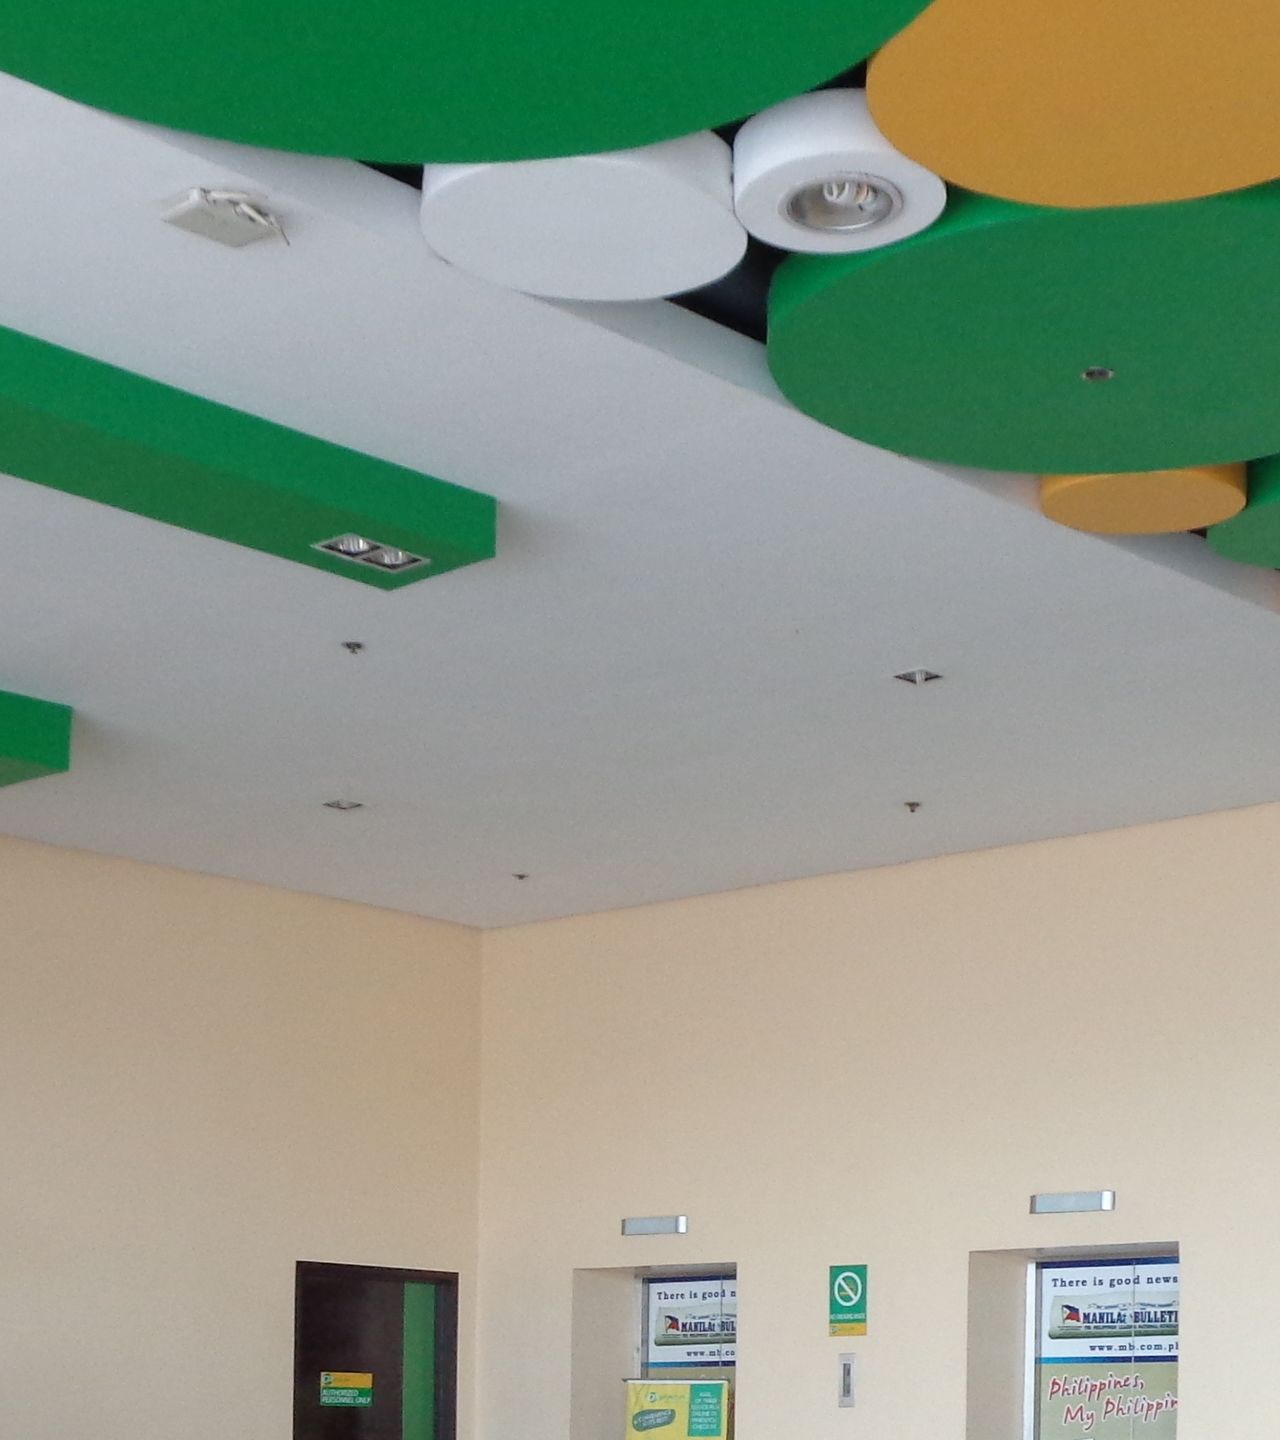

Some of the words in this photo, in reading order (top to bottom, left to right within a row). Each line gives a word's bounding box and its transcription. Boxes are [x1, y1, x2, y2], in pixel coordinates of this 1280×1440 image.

[1052, 1277, 1088, 1288] There
[1093, 1276, 1104, 1286] is
[1109, 1275, 1141, 1288] good
[1146, 1276, 1179, 1284] news
[657, 1290, 685, 1300] There
[689, 1290, 698, 1299] is
[702, 1289, 726, 1301] good
[1082, 1311, 1123, 1324] MANILA
[680, 1321, 714, 1333] MANILA
[322, 1388, 359, 1397] AUTHORIZED
[1048, 1373, 1144, 1401] Philippines,
[322, 1396, 354, 1404] PERSONNEL
[354, 1396, 371, 1404] ONLY
[1063, 1405, 1095, 1431] My
